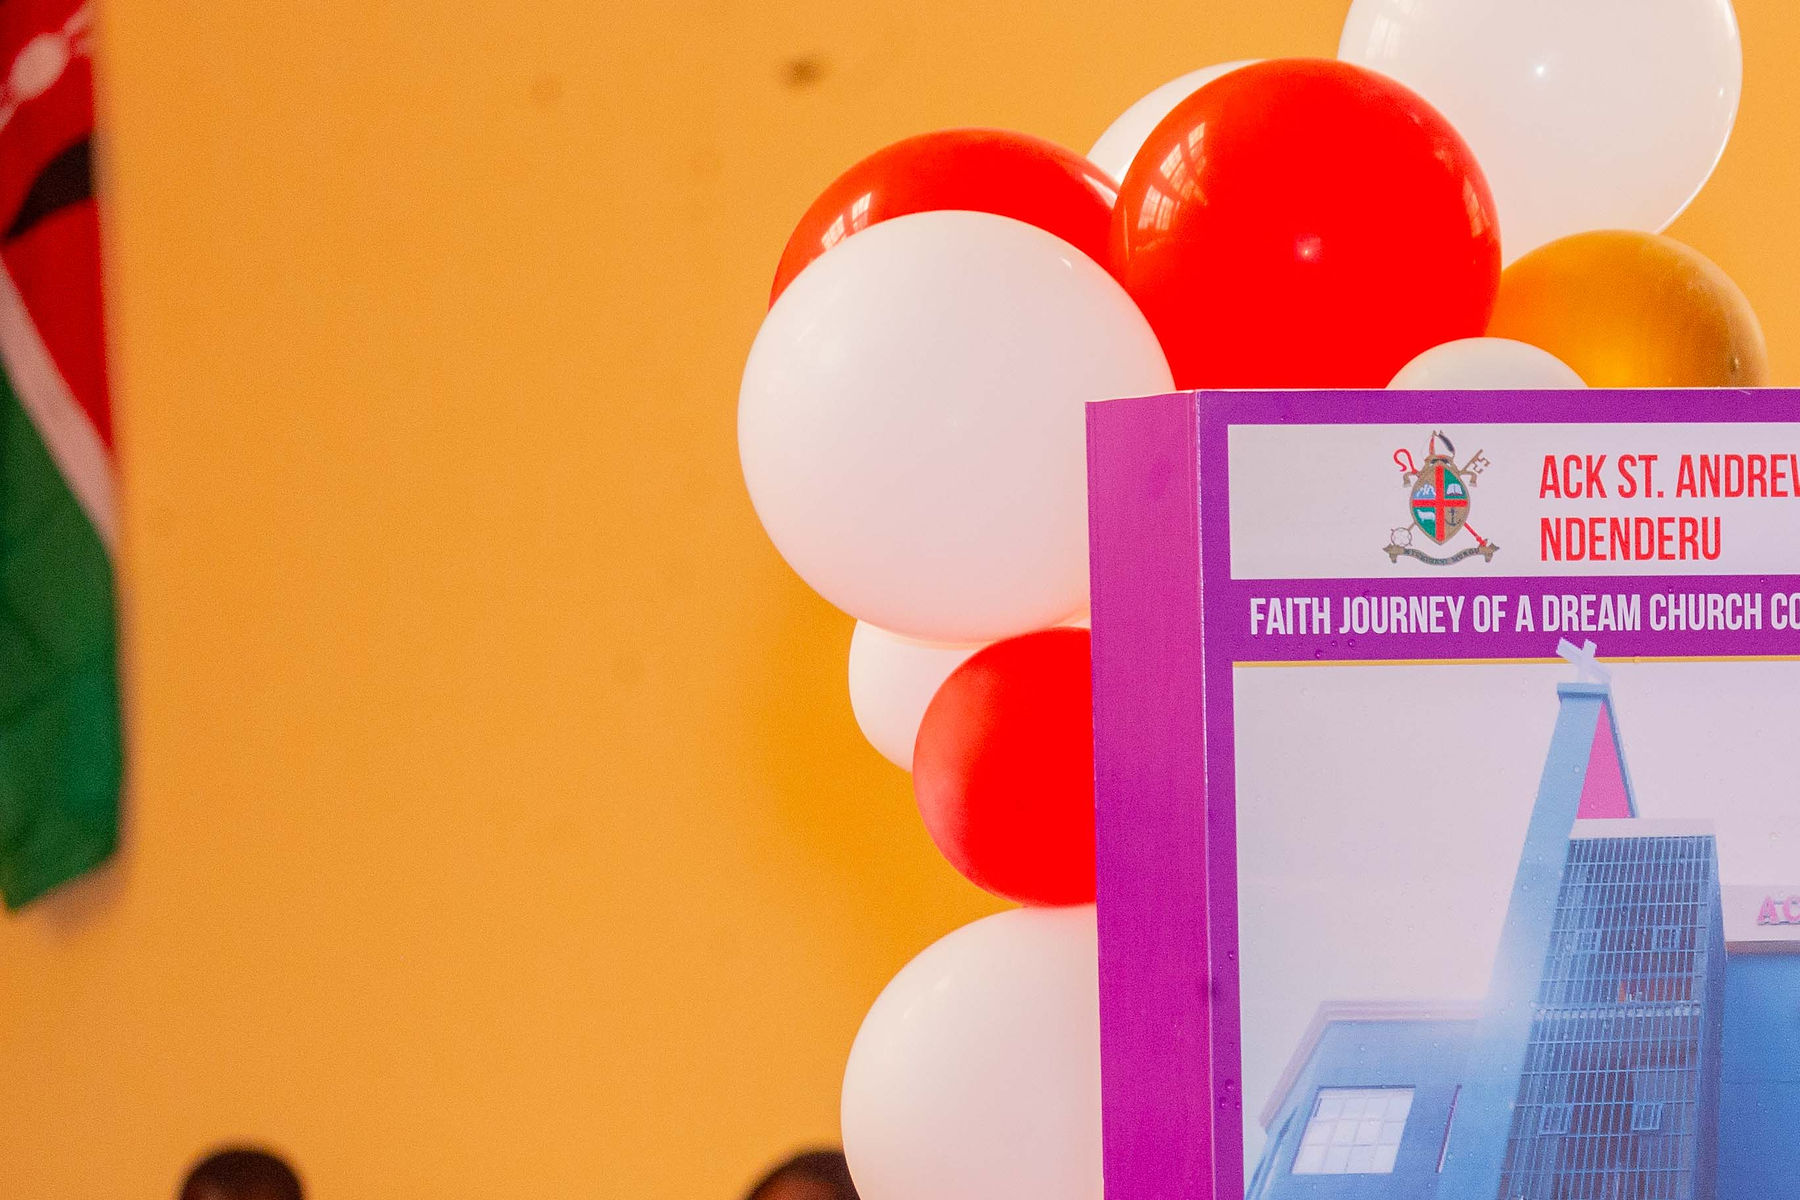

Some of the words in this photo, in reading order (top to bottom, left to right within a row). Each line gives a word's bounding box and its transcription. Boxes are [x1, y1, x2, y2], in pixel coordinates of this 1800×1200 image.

[1539, 454, 1607, 499] ACK
[1617, 453, 1666, 498] ST.
[1540, 517, 1721, 561] NDENDERU
[1250, 597, 1331, 635] FAITH
[1339, 595, 1465, 634] JOURNEY
[1473, 595, 1507, 633] OF
[1516, 595, 1536, 633] A
[1543, 593, 1641, 632] DREAM
[1649, 593, 1762, 631] CHURCH
